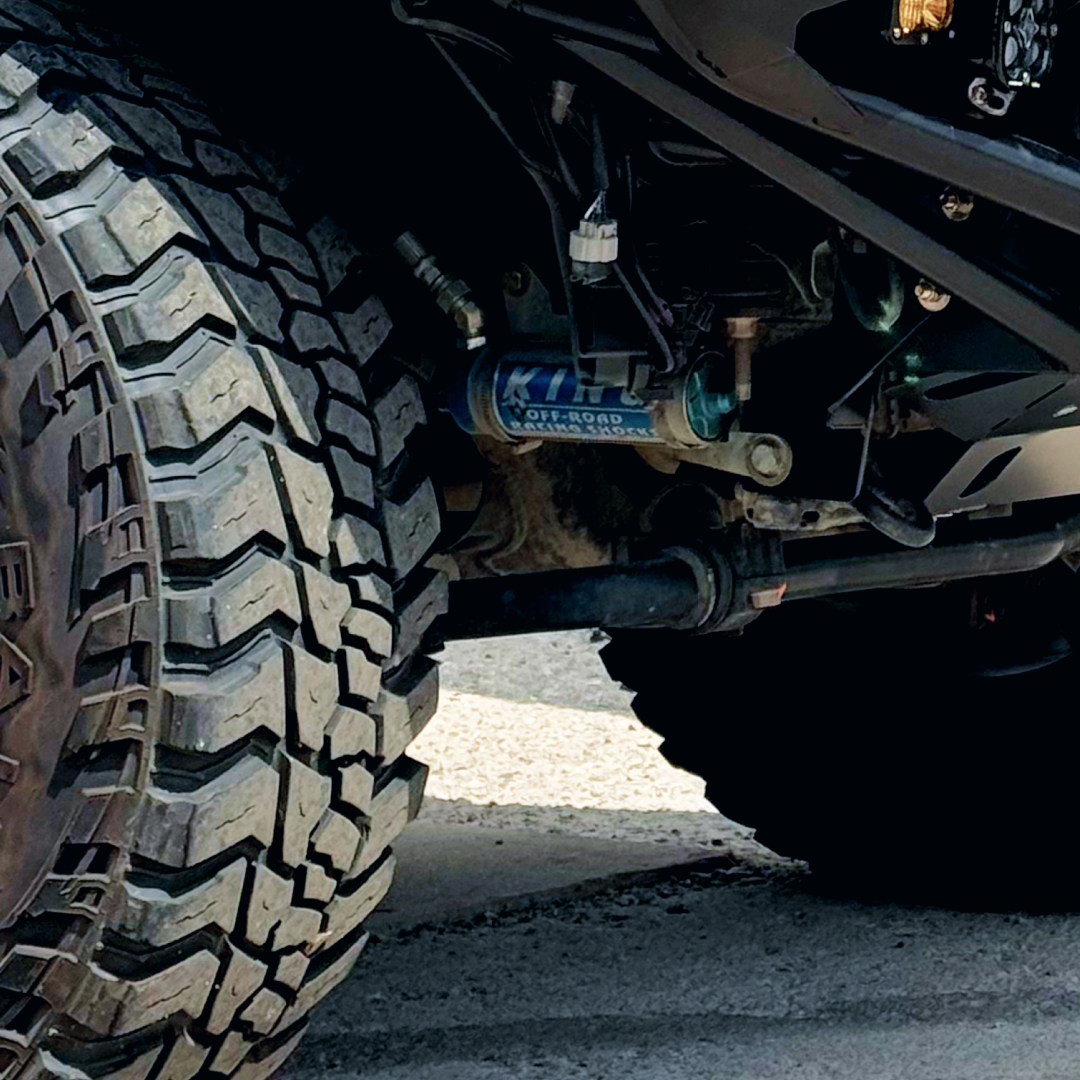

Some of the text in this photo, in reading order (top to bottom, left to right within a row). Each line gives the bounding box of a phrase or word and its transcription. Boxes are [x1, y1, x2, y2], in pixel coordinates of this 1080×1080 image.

[502, 366, 648, 407] KIN
[526, 409, 623, 425] OFF-ROAD
[510, 421, 582, 434] RACING
